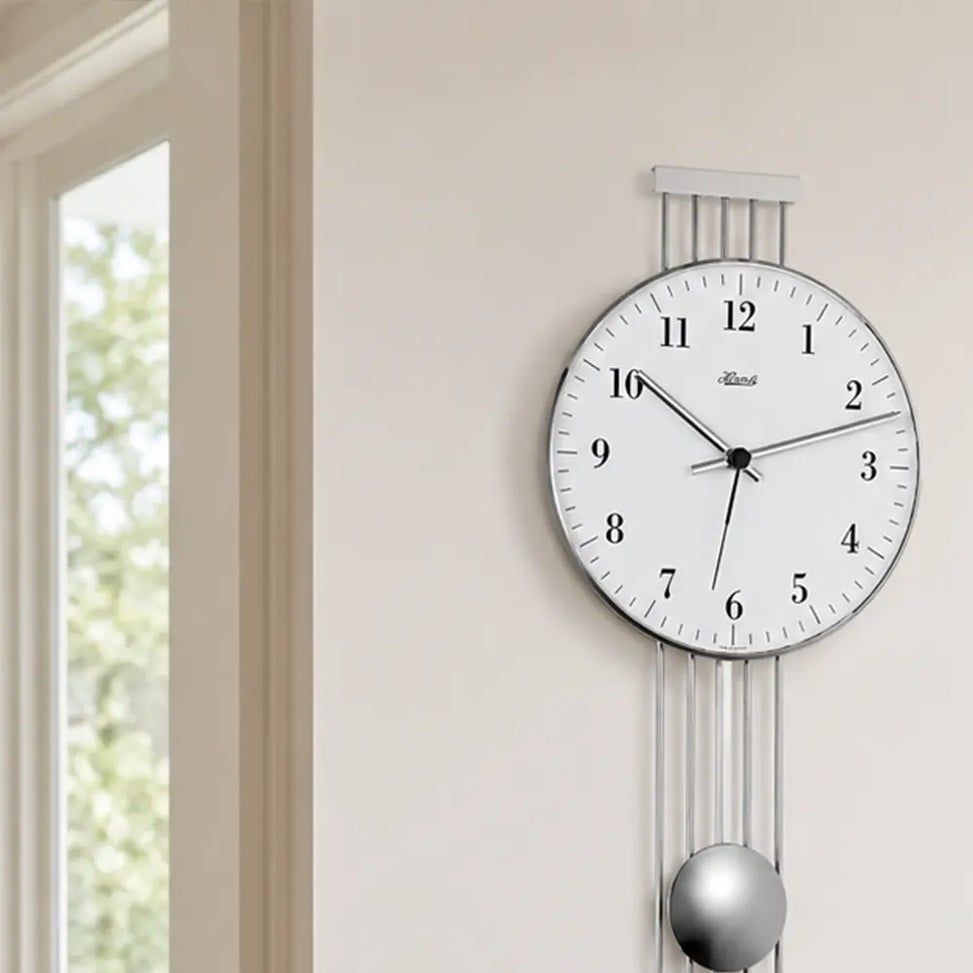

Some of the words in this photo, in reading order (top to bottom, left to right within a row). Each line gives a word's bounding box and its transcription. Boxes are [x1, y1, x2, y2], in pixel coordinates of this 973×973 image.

[723, 300, 756, 332] 12
[660, 317, 690, 348] 11
[802, 325, 815, 355] 1
[609, 368, 643, 399] 10
[845, 380, 863, 411] 2
[591, 438, 610, 469] 9
[861, 451, 878, 481] 3
[605, 513, 624, 544] 8
[840, 523, 860, 554] 4
[659, 568, 677, 600] 7
[792, 573, 808, 604] 5
[725, 590, 744, 621] 6
